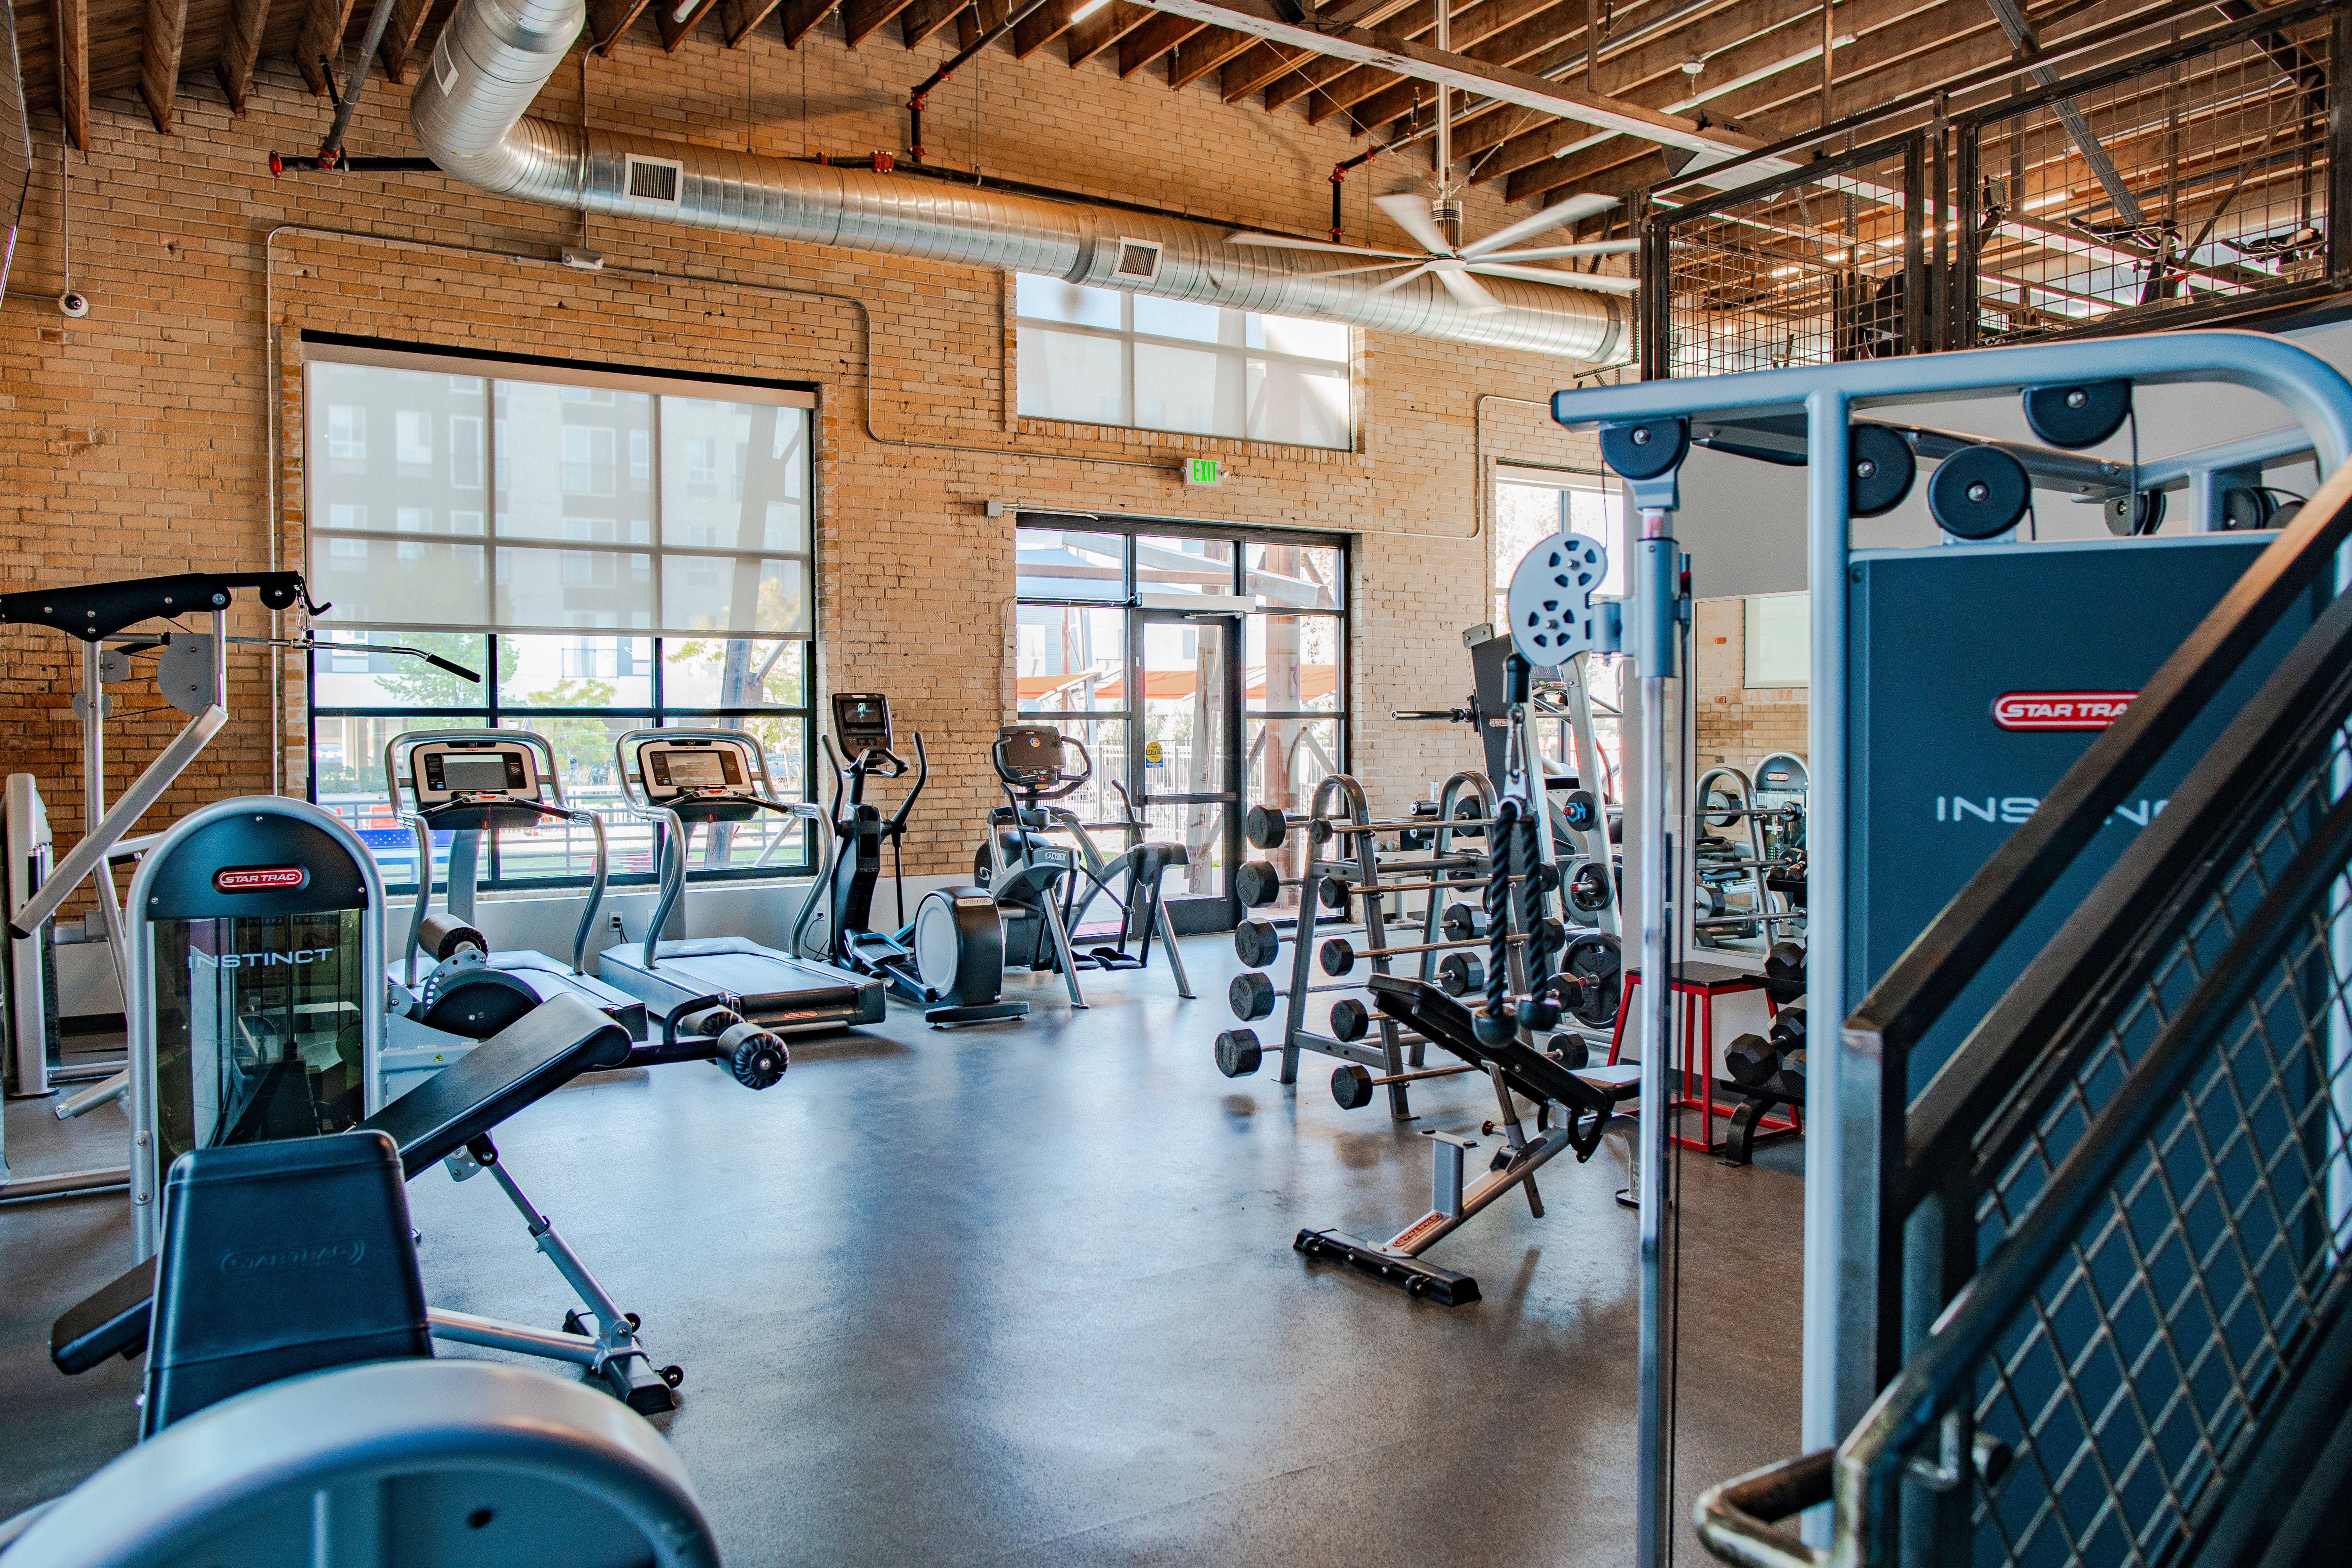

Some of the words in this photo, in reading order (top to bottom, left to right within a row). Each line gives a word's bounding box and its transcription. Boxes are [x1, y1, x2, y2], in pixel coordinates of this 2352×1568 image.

[1193, 459, 1217, 483] EXIT
[2001, 703, 2074, 717] STAR
[2076, 703, 2128, 717] TRA
[1051, 852, 1066, 861] CYBEX
[223, 875, 259, 884] STAR
[261, 874, 296, 882] TRAC
[188, 948, 334, 969] INSTINCT
[1417, 1215, 1437, 1230] STAR
[1397, 1228, 1419, 1244] TRAC
